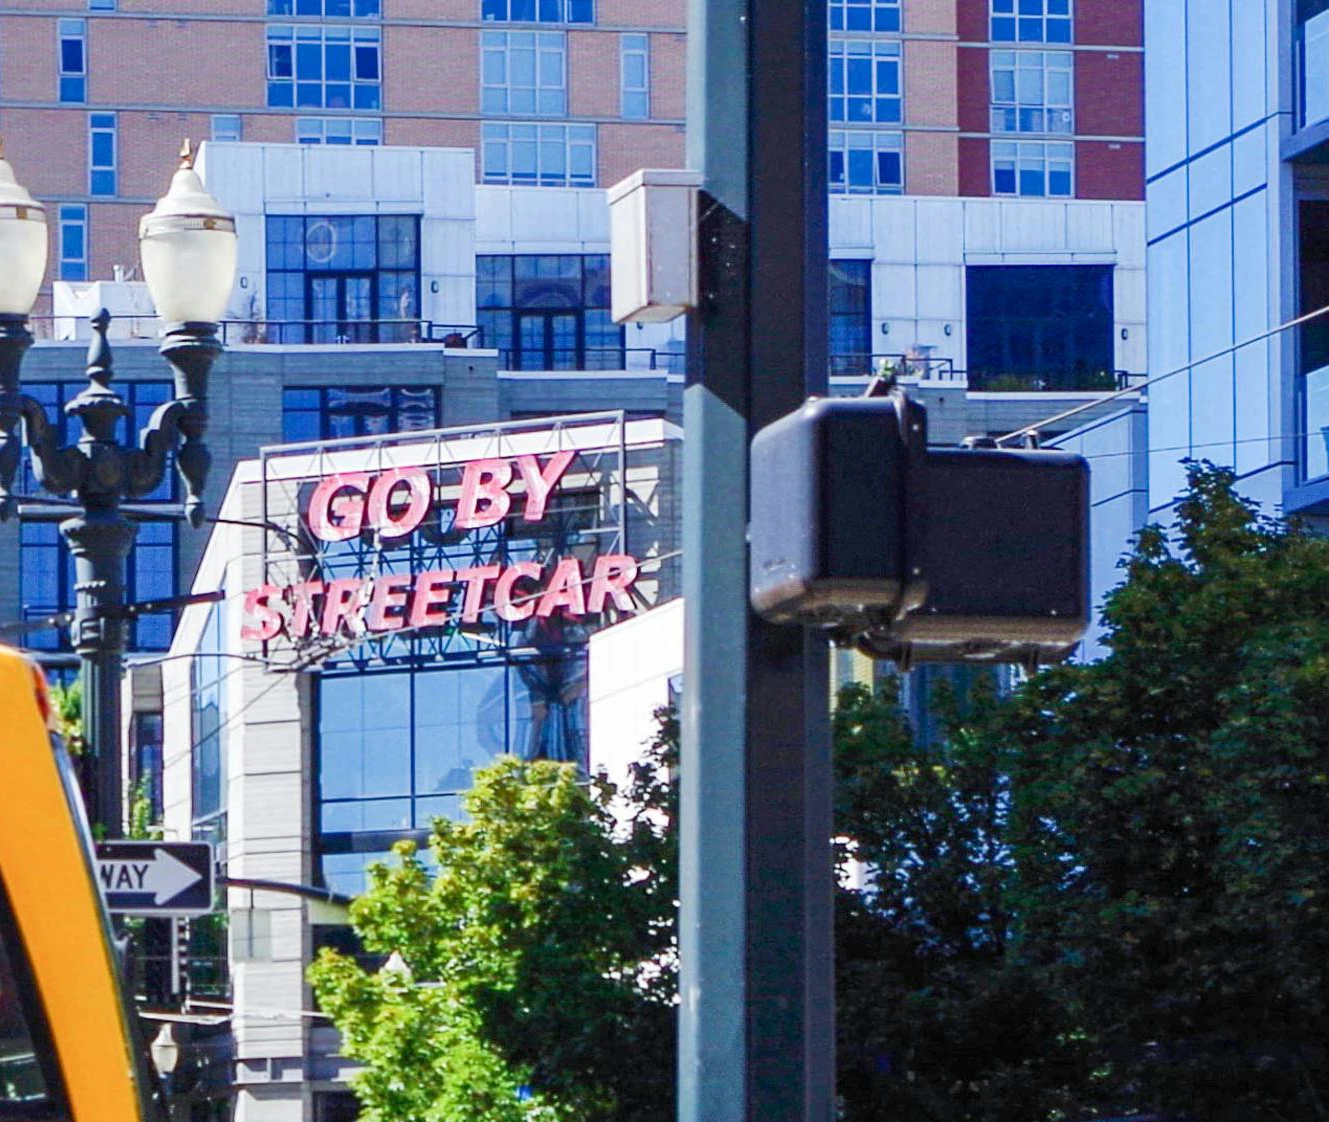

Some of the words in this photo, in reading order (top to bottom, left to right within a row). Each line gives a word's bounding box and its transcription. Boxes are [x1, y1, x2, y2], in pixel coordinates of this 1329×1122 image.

[307, 467, 433, 542] GO
[455, 451, 579, 529] BY
[240, 554, 640, 640] STREETCAR
